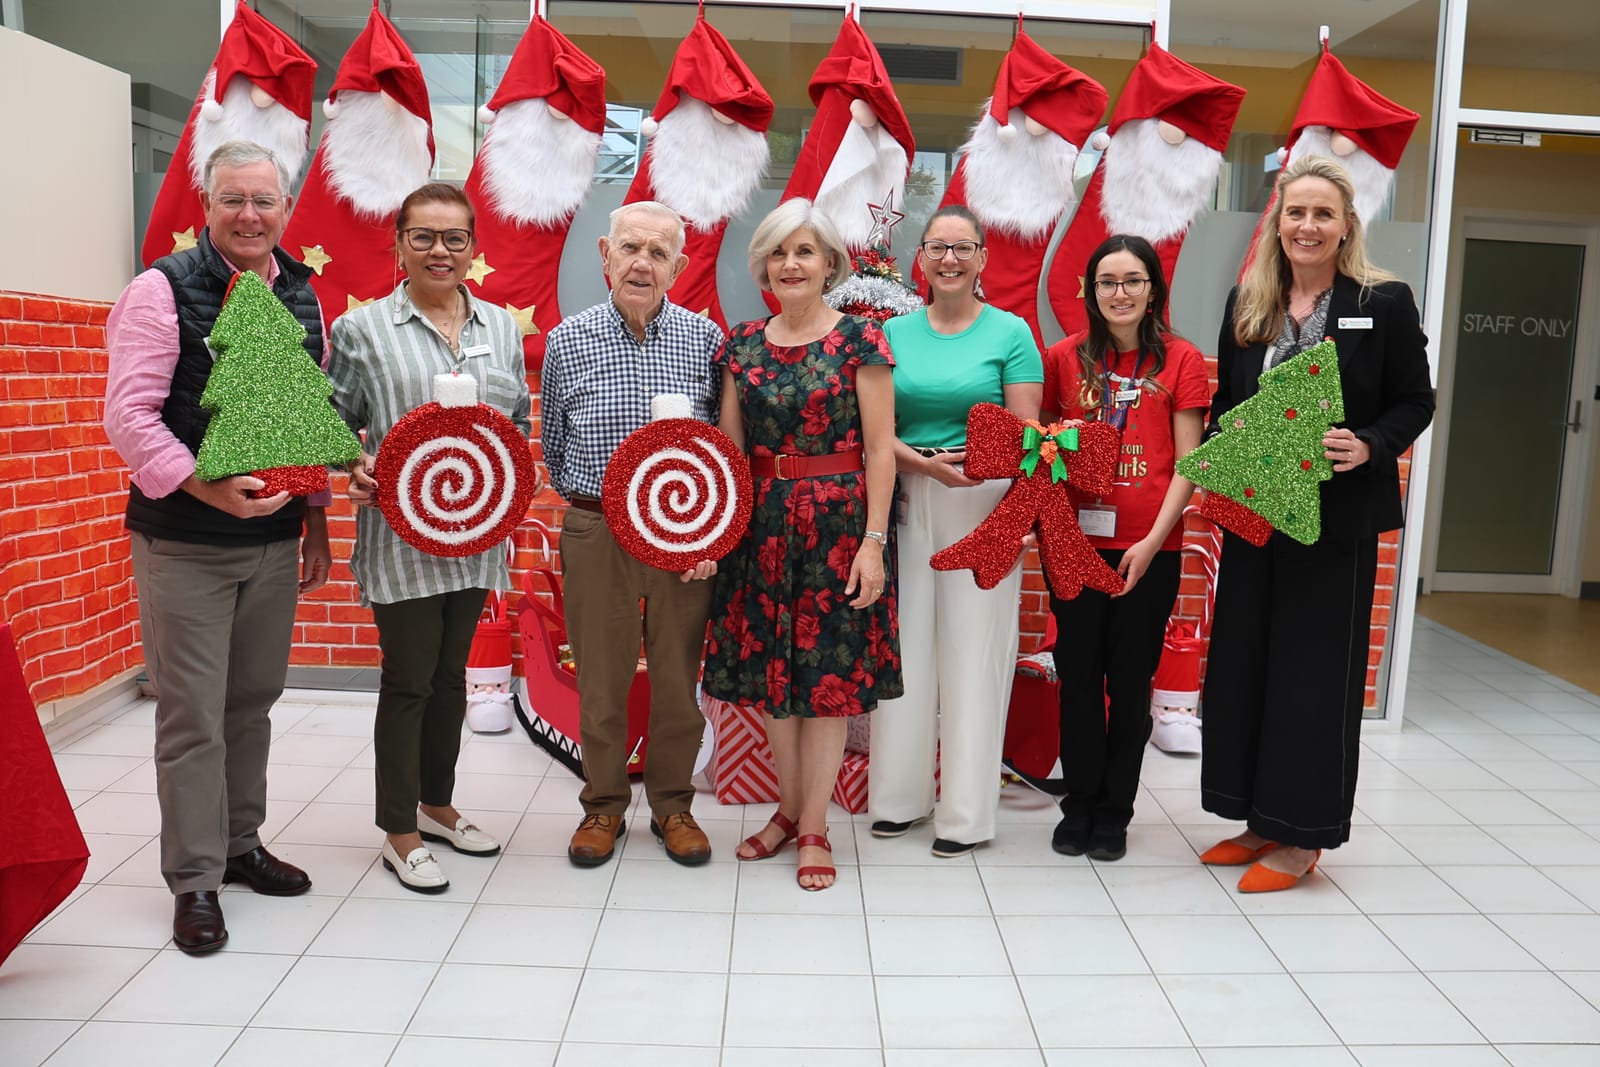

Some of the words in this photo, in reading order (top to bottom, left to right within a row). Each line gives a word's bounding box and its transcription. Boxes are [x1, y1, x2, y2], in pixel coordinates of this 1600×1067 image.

[1463, 313, 1516, 335] STAFF
[1520, 316, 1572, 338] ONLY
[1120, 443, 1143, 455] rom
